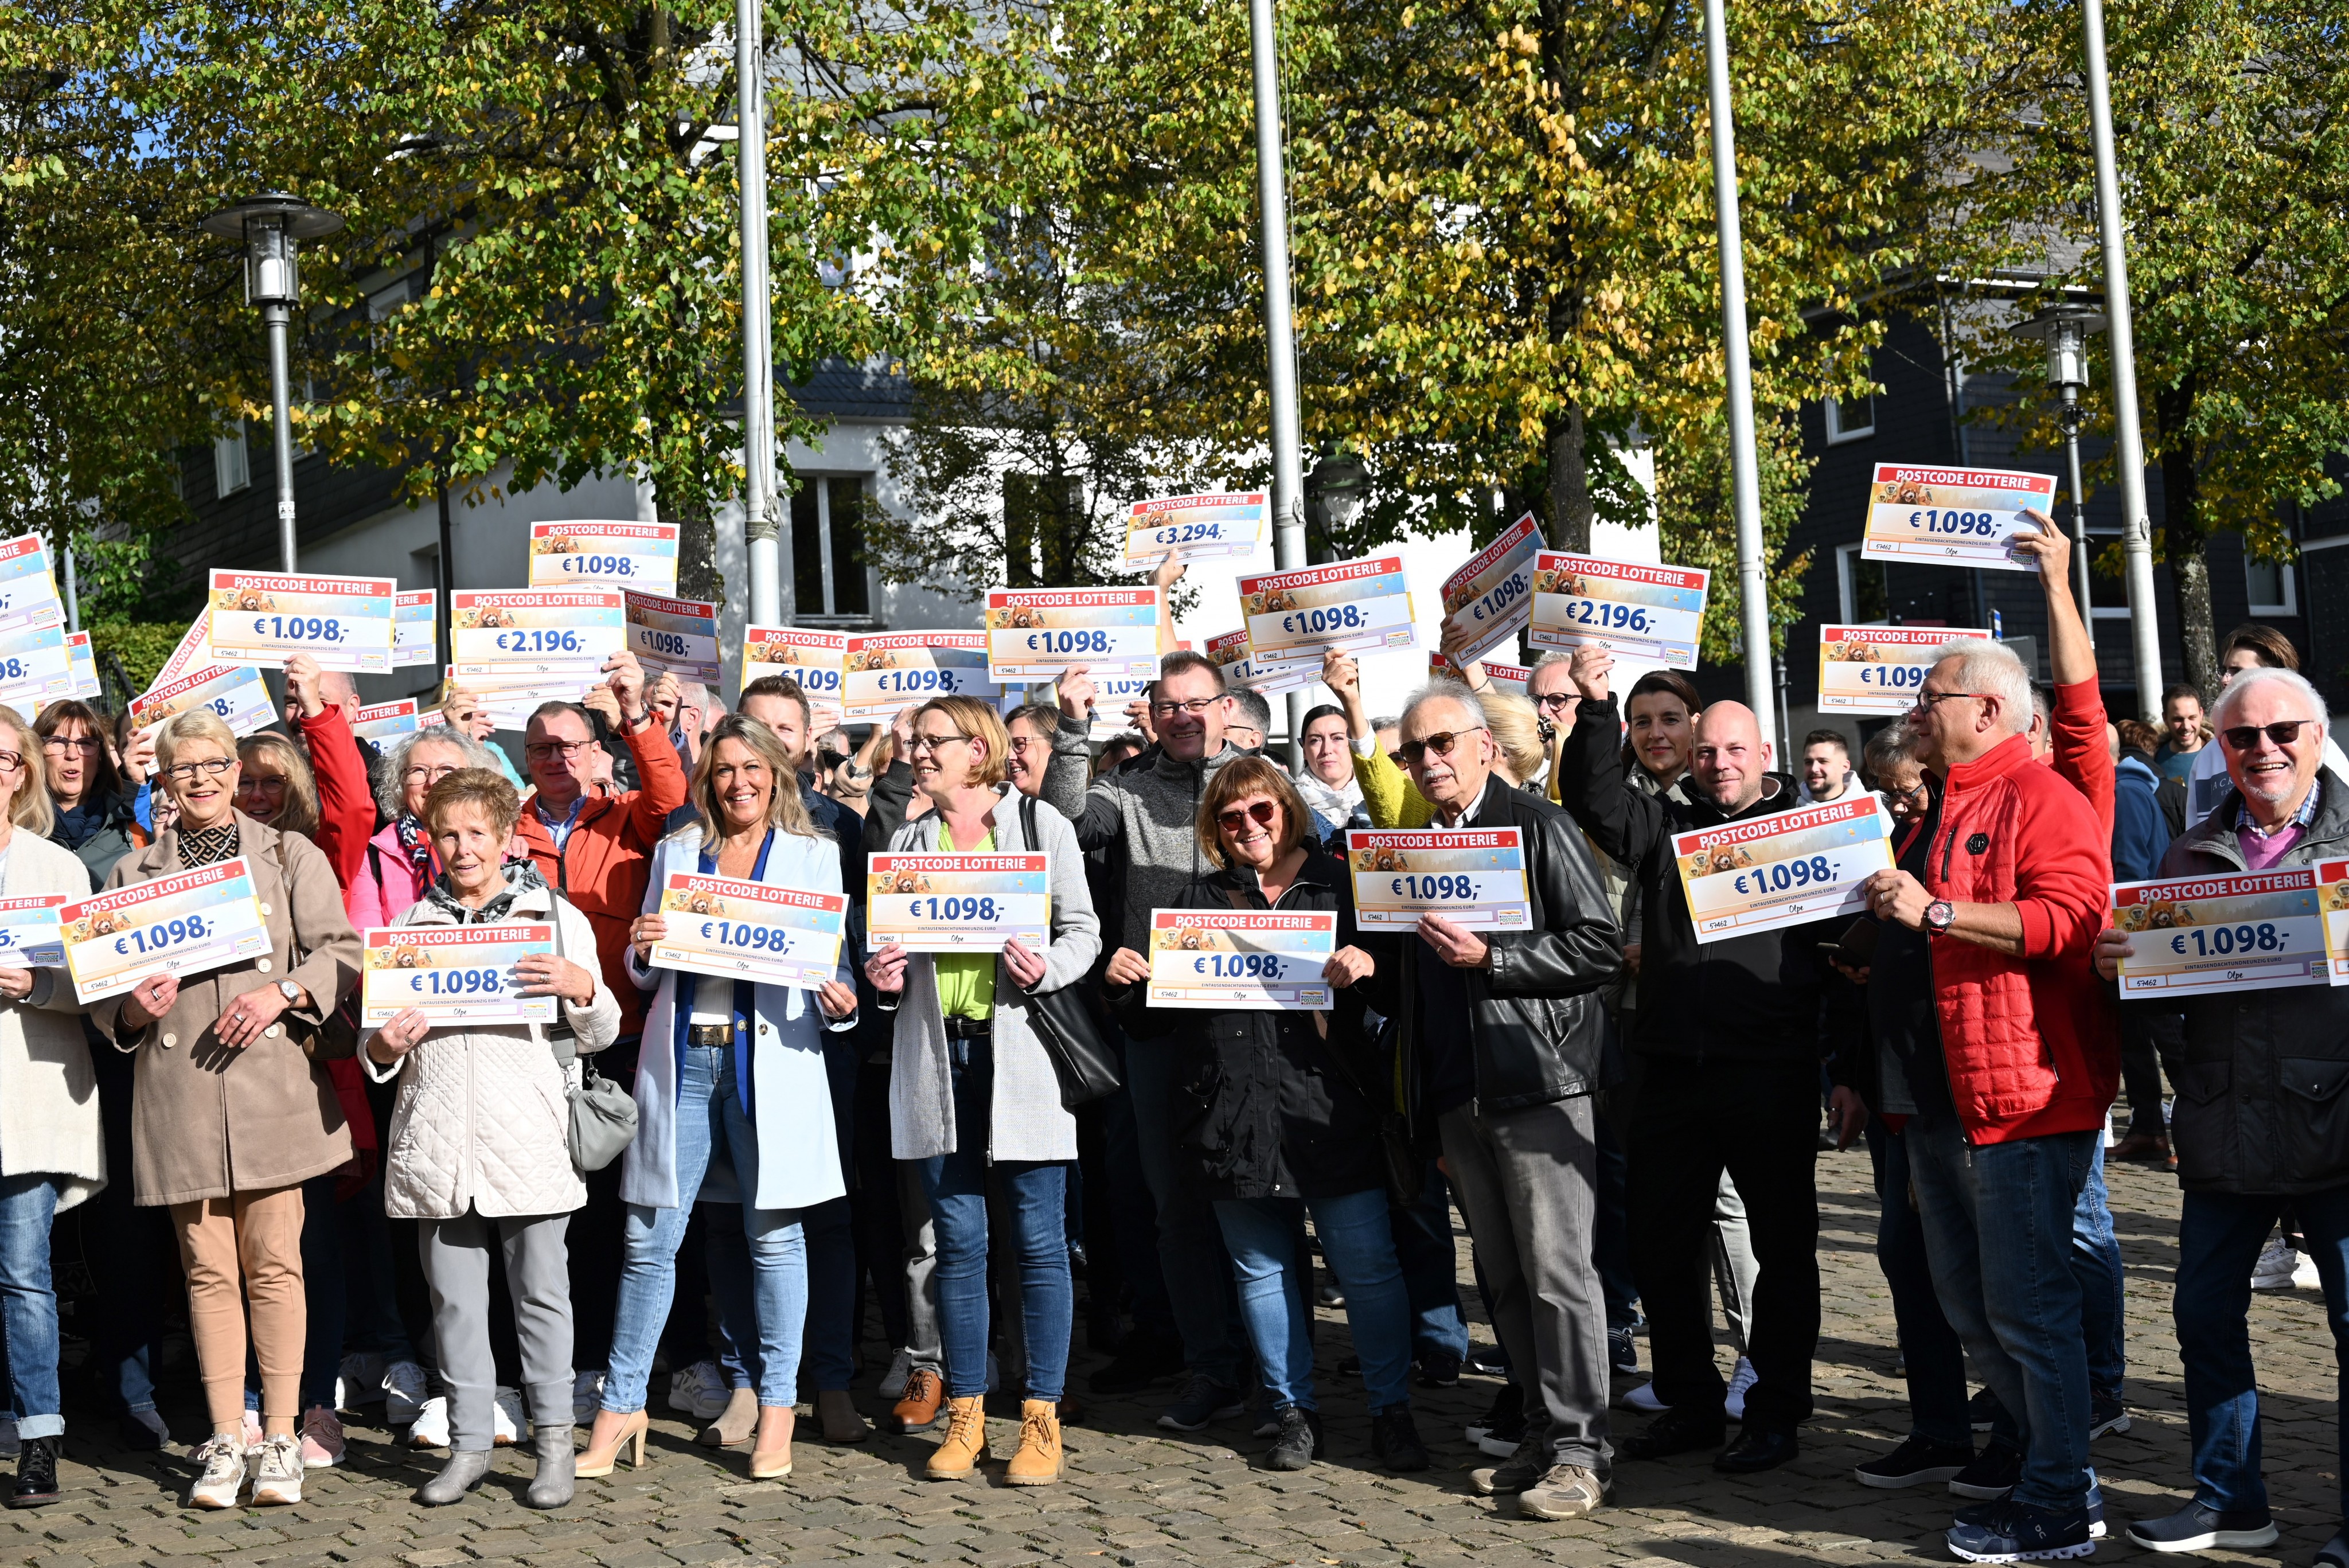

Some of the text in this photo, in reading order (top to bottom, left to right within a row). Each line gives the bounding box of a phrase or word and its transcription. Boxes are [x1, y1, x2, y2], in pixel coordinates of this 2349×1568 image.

[1895, 469, 2030, 489] POSTCODE LOTTERIE
[1146, 495, 1249, 512] POSTCODE LOTTERIE
[548, 525, 660, 537] POSTCODE LOTTERIE
[1908, 510, 2001, 538] € 1.098,-
[1155, 522, 1227, 544] € 3.294,-
[1914, 537, 1979, 545] EINTAUSENDACHTUNDNEUNZIG
[1447, 526, 1524, 592] POSTCODE LOTTERIE
[1945, 547, 1958, 557] Olpe
[561, 556, 639, 576] € 1.098,-
[1553, 557, 1685, 586] POSTCODE LOTTERIE
[1257, 561, 1383, 590] POSTCODE LOTTERIE
[234, 576, 373, 594] POSTCODE LOTTERIE
[474, 594, 604, 606] POSTCODE LOTTERIE
[627, 593, 700, 616] POSTCODE LOTTERIE
[1006, 592, 1136, 606] POSTCODE LOTTERIE
[1472, 570, 1527, 624] € 1.098,-
[1281, 603, 1368, 633] € 1.098,-
[1509, 614, 1518, 626] Olpe
[1565, 601, 1656, 634] € 2.196,-
[253, 617, 349, 643] € 1.098,-
[1843, 630, 1908, 642] POSTCODE
[495, 630, 586, 653] € 2.196,-
[640, 630, 690, 657] € 1.098,-
[765, 631, 826, 646] POSTCODE
[863, 635, 985, 649] POSTCODE LOTTERIE
[1026, 630, 1116, 653] € 1.098,-
[1294, 633, 1352, 645] EINTAUSENDACHTUNDNEUNZIG
[1598, 640, 1612, 650] Olpe
[1465, 643, 1478, 656] 57462
[1664, 655, 1688, 663] POSTCODE
[536, 665, 549, 673] Olpe
[1232, 665, 1241, 678] €
[1860, 668, 1871, 682] €
[877, 668, 963, 692] € 1.098,-
[141, 678, 191, 708] POSTCODE
[527, 690, 539, 699] Olpe
[1897, 699, 1909, 708] Olpe
[356, 705, 400, 721] LOTTERIE
[1698, 803, 1854, 848] POSTCODE LOTTERIE
[1368, 833, 1498, 847] POSTCODE LOTTERIE
[891, 858, 1026, 869] POSTCODE LOTTERIE
[1732, 855, 1840, 895] € 1.098,-
[80, 867, 225, 916] POSTCODE LOTTERIE
[688, 877, 824, 907] POSTCODE LOTTERIE
[1390, 875, 1481, 900] € 1.098,-
[2138, 872, 2310, 902] POSTCODE LOTTERIE
[0, 898, 45, 910] TTERIE
[1749, 889, 1823, 908] EINTAUSENDACHTUNDNEUNZIG
[909, 897, 1004, 922] € 1.098,-
[1788, 903, 1804, 915] Olpe
[1176, 915, 1312, 928] POSTCODE LOTTERIE
[1708, 919, 1727, 929] 57462
[112, 914, 214, 956] € 1.098,-
[389, 928, 530, 945] POSTCODE LOTTERIE
[699, 921, 795, 954] € 1.098,-
[950, 935, 963, 943] Olpe
[2169, 923, 2289, 957] € 1.098,-
[128, 945, 198, 968] EINTAUSENDACHTUNDNEUNZIG
[664, 951, 681, 959] 57462
[705, 947, 771, 961] EINTAUSENDACHTUNDNEUNZIG
[165, 958, 181, 970] Olpe
[735, 961, 750, 971] Olpe
[1193, 955, 1287, 980] € 1.098,-
[2184, 958, 2266, 970] EINTAUSENDACHTUNDNEUNZIG
[410, 969, 508, 994] € 1.098,-
[2137, 978, 2157, 988] 57462
[2226, 970, 2243, 981] Olpe
[90, 979, 108, 990] 57462
[1233, 992, 1247, 1000] Olpe
[453, 1008, 467, 1017] Olpe
